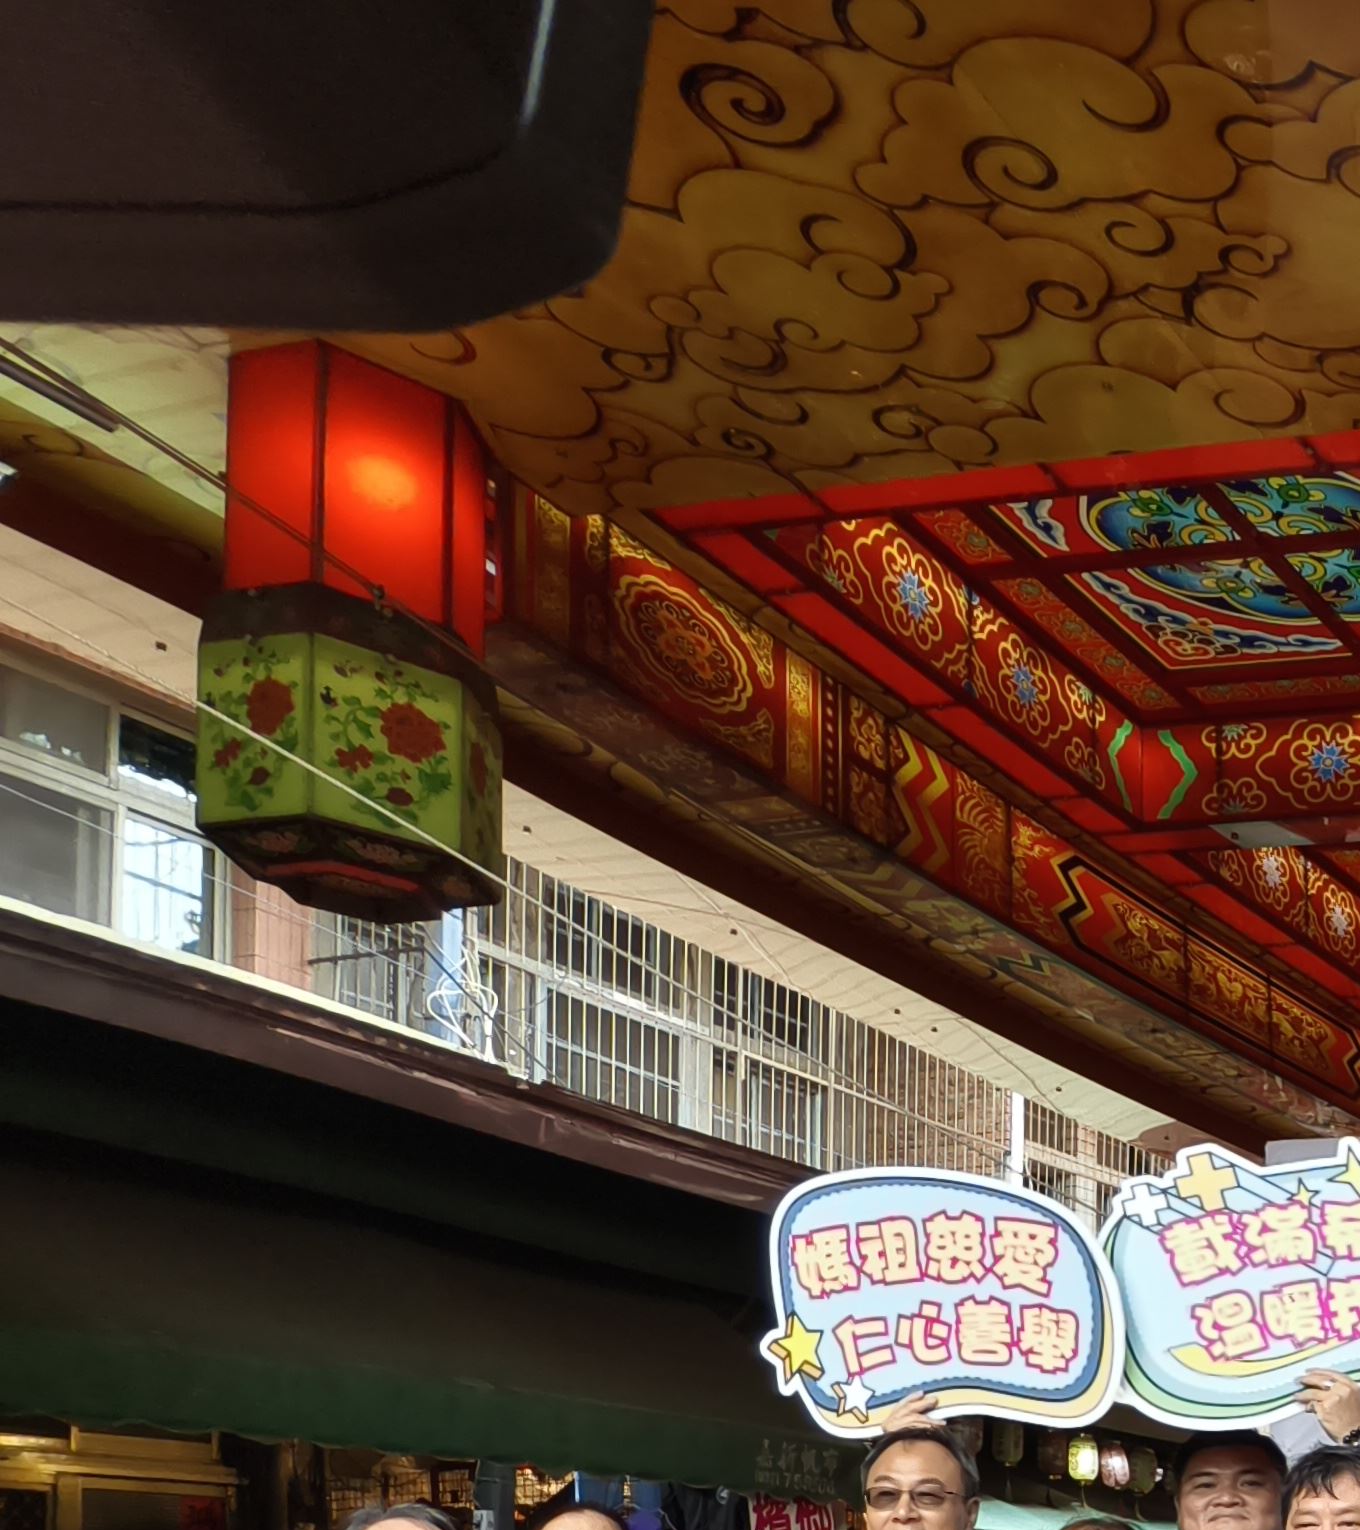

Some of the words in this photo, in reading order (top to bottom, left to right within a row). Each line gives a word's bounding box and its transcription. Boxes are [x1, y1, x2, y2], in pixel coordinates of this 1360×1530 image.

[791, 1209, 1059, 1299] 媽祖慈愛
[832, 1295, 1080, 1377] 仁心善舉
